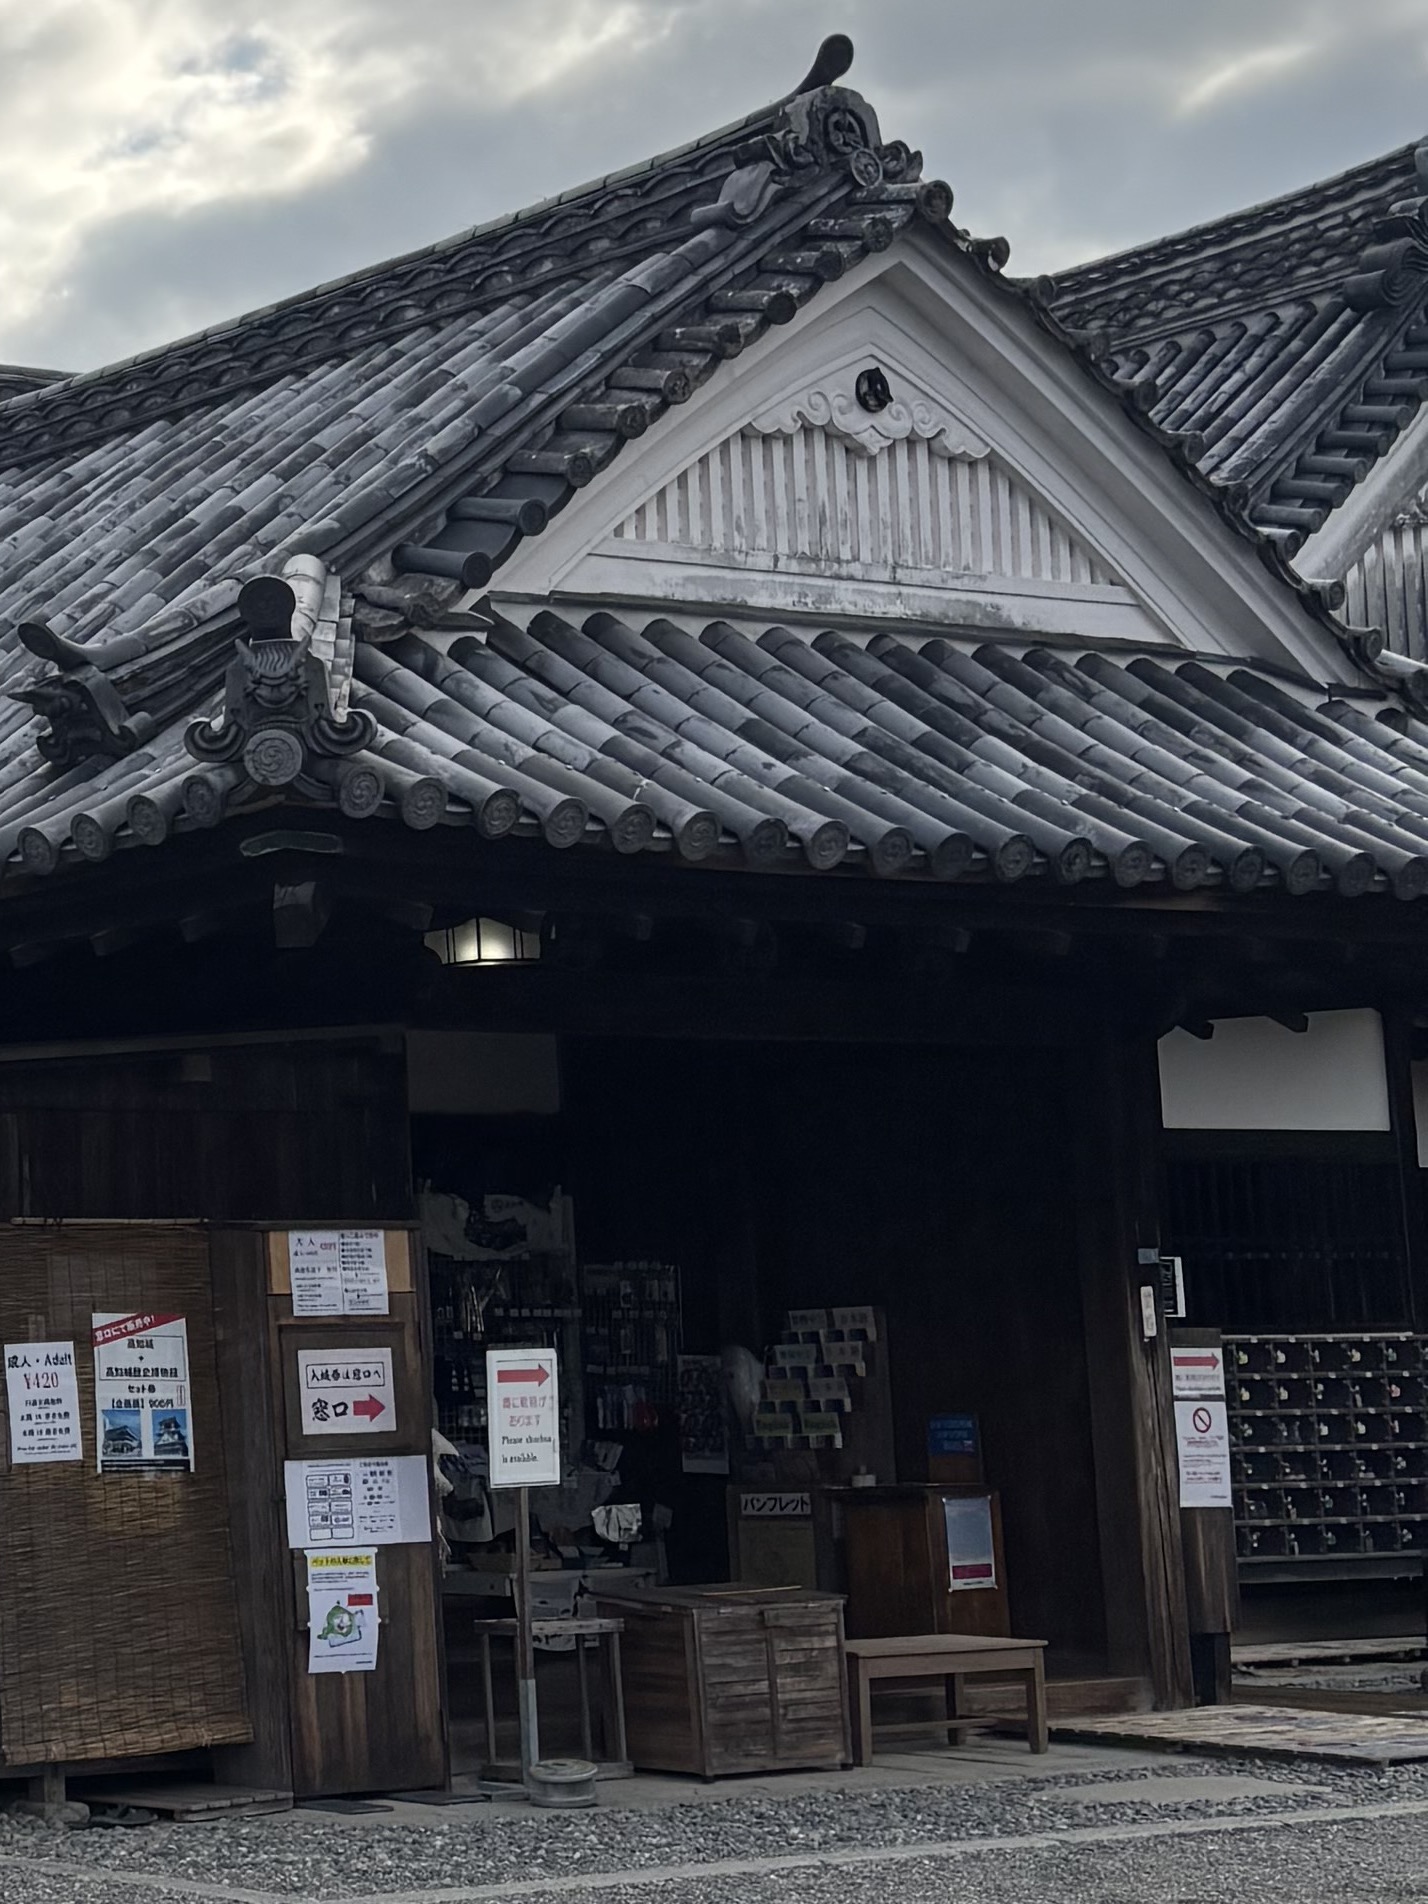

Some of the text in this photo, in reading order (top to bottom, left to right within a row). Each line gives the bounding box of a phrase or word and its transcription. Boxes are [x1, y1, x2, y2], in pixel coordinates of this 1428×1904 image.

[312, 1397, 349, 1422] 窓口
[744, 1496, 810, 1512] パンフレット
